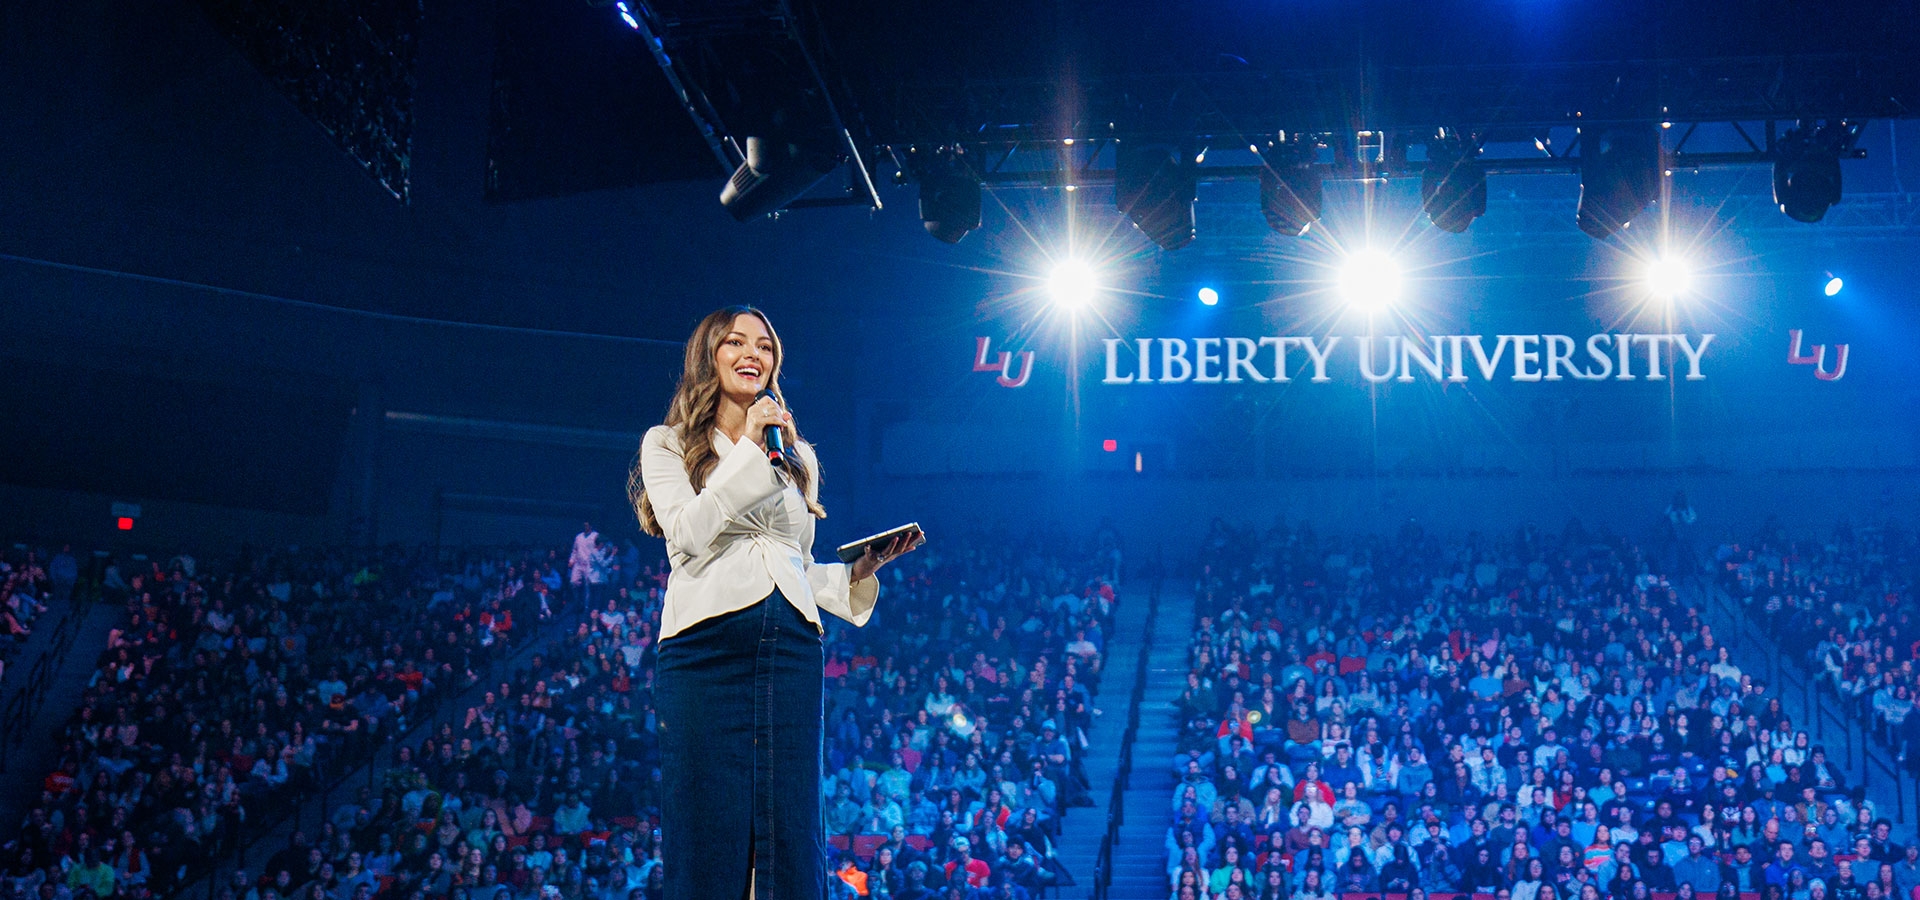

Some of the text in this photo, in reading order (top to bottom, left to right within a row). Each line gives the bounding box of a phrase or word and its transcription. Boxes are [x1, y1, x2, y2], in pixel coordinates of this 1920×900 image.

[973, 336, 1034, 387] LU
[1102, 333, 1715, 384] LIBERTY UNIVERSITY
[1788, 329, 1849, 381] LU
